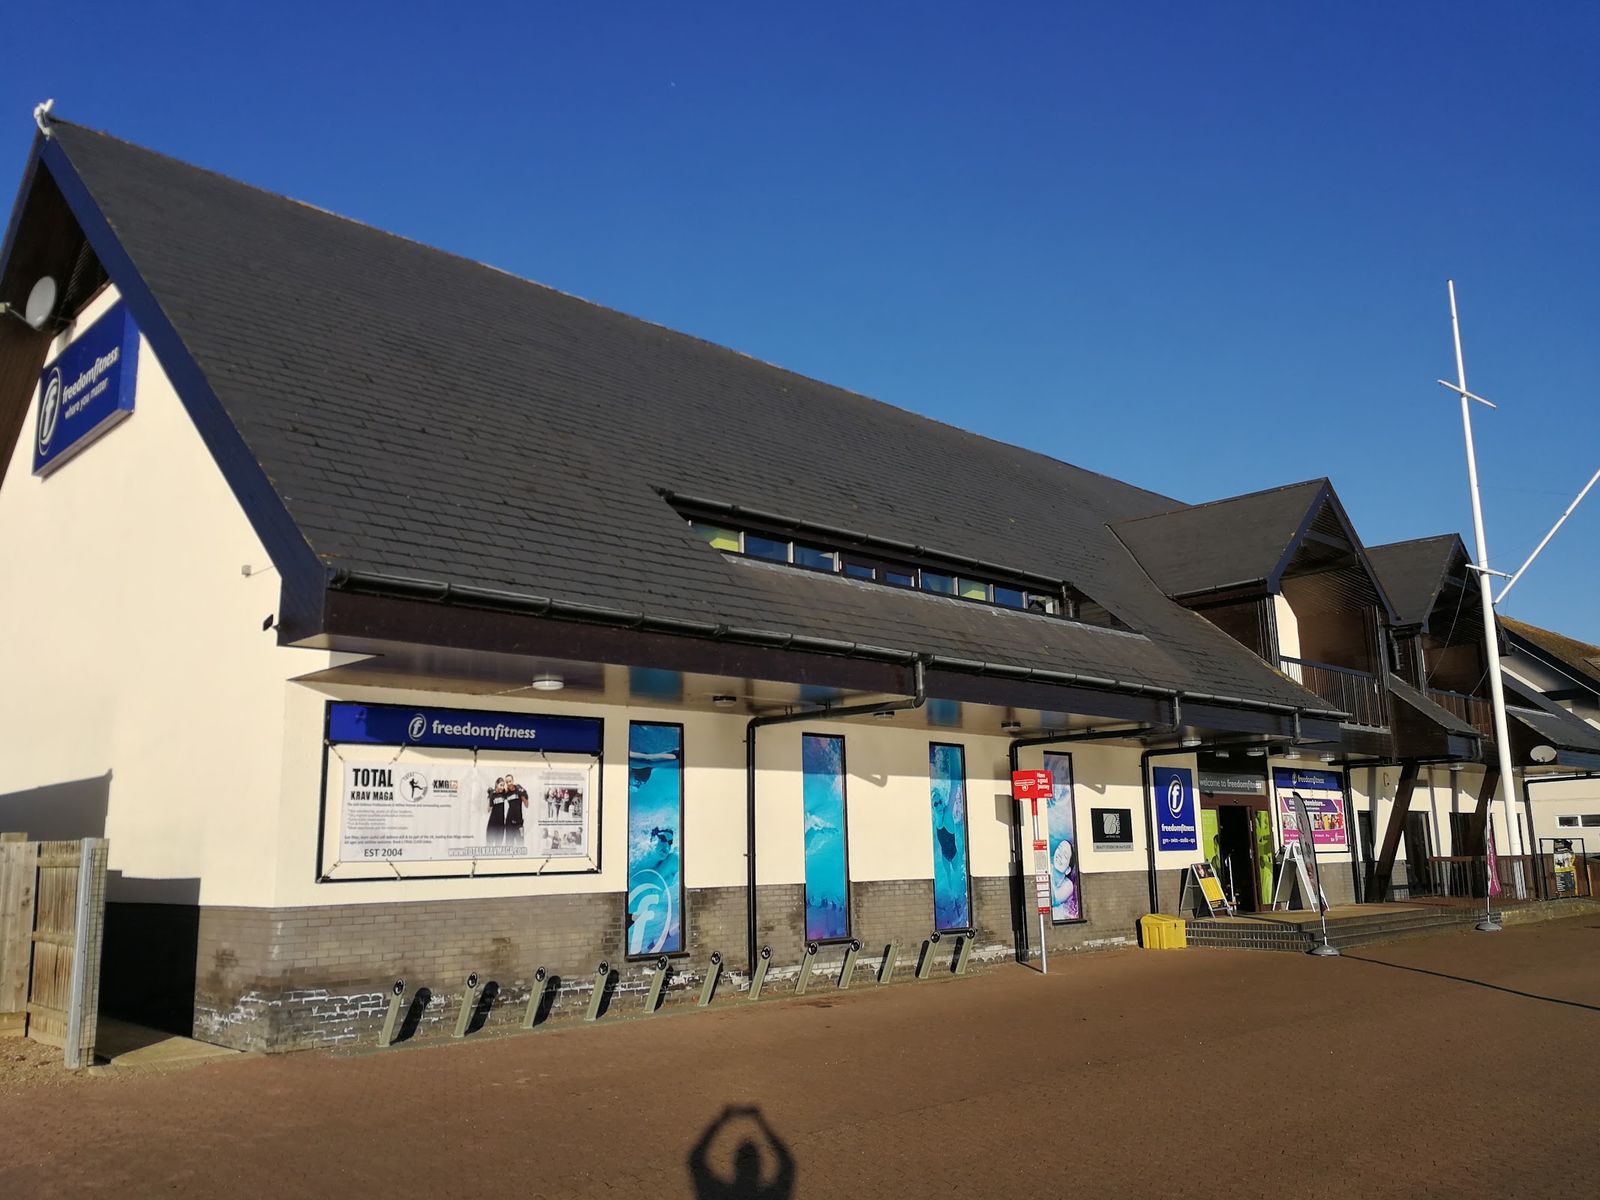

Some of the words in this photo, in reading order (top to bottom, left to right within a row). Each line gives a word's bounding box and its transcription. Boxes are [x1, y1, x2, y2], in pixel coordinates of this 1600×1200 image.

[63, 346, 120, 404] freedomfitness
[80, 393, 90, 412] you
[432, 720, 536, 740] freedomfitness
[352, 768, 393, 788] TOTAL
[1200, 777, 1221, 787] welcome
[1221, 780, 1227, 788] to
[1227, 778, 1262, 790] freedomfitness
[351, 791, 371, 800] KRAV
[373, 791, 394, 801] MAGA
[1161, 823, 1194, 833] freedomfitness
[364, 848, 380, 857] EST
[382, 848, 403, 857] 2004
